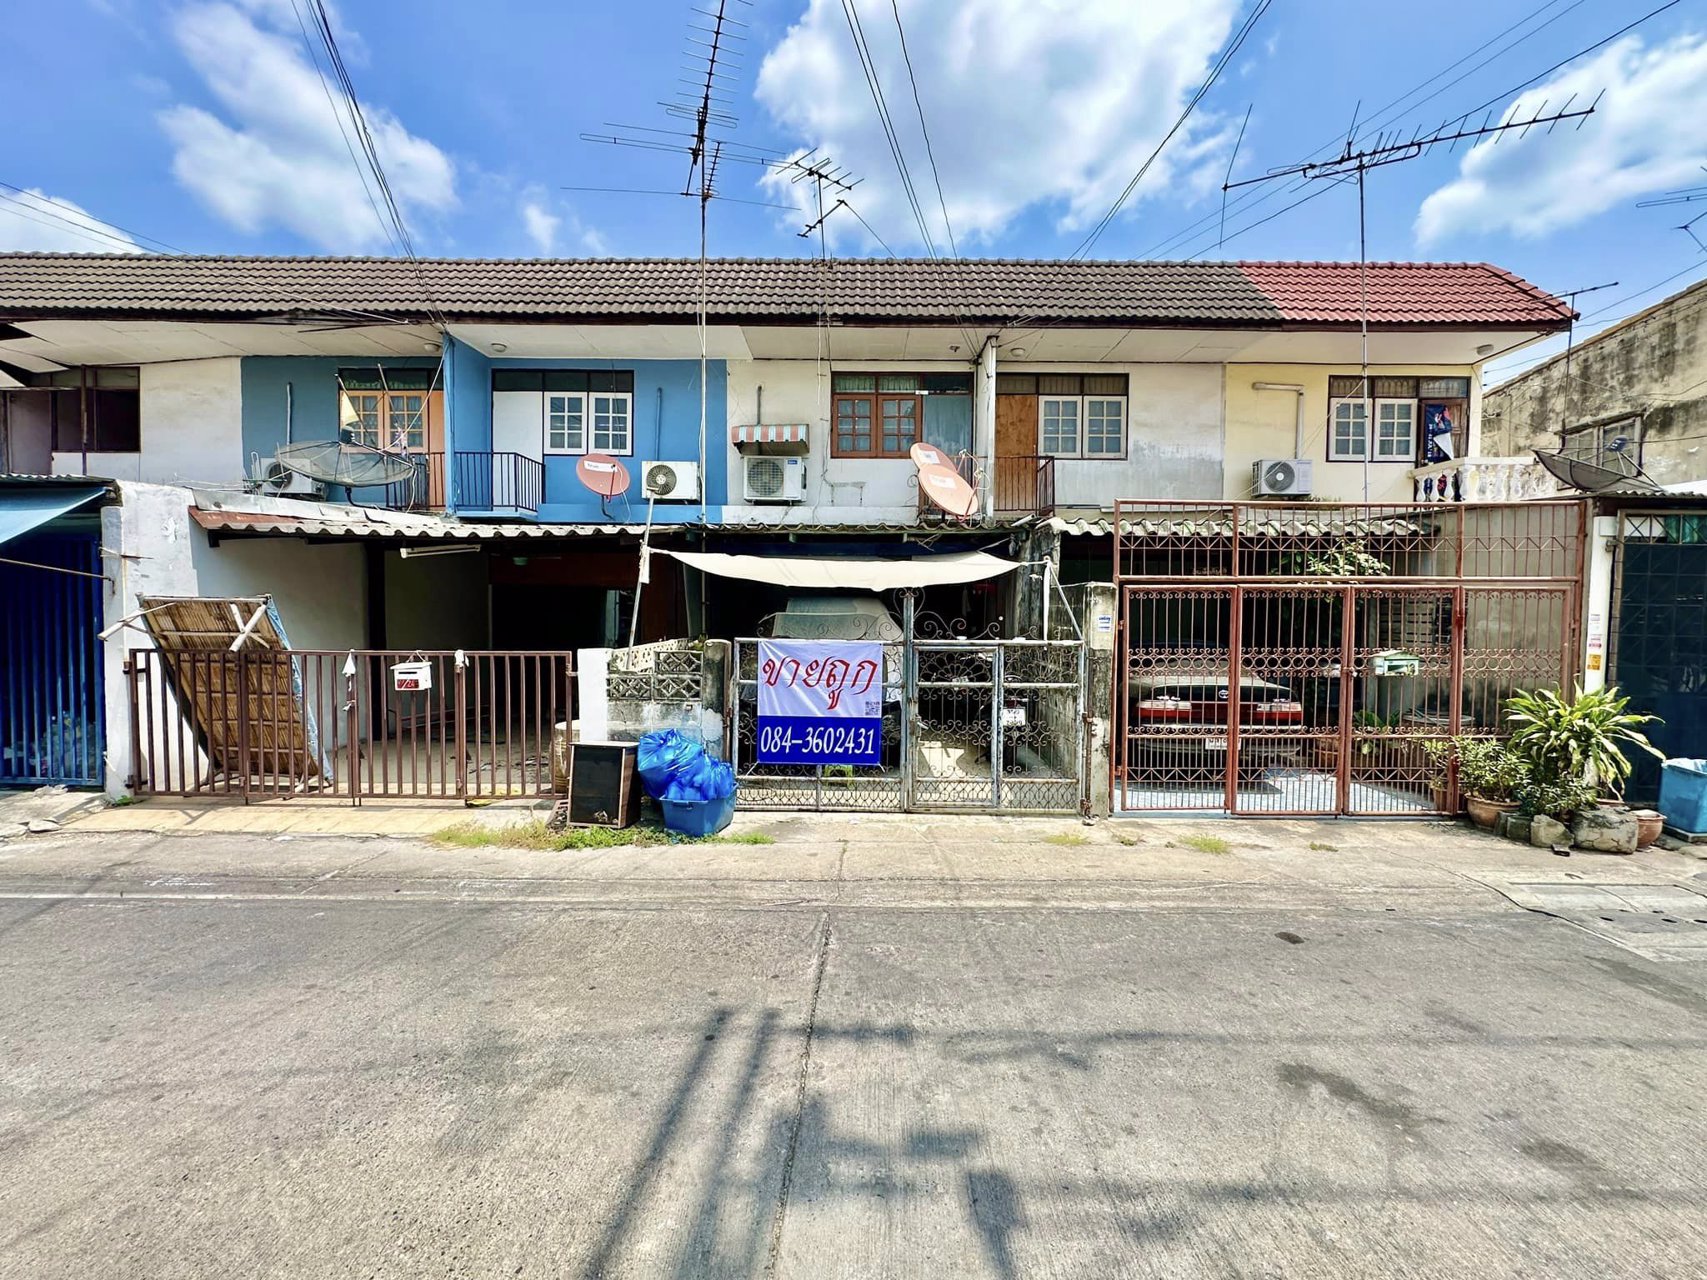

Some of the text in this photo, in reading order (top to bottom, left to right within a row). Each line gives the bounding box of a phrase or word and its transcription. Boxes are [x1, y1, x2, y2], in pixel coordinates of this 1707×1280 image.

[762, 656, 878, 710] ขายถูก
[760, 726, 875, 755] 084-3602431
